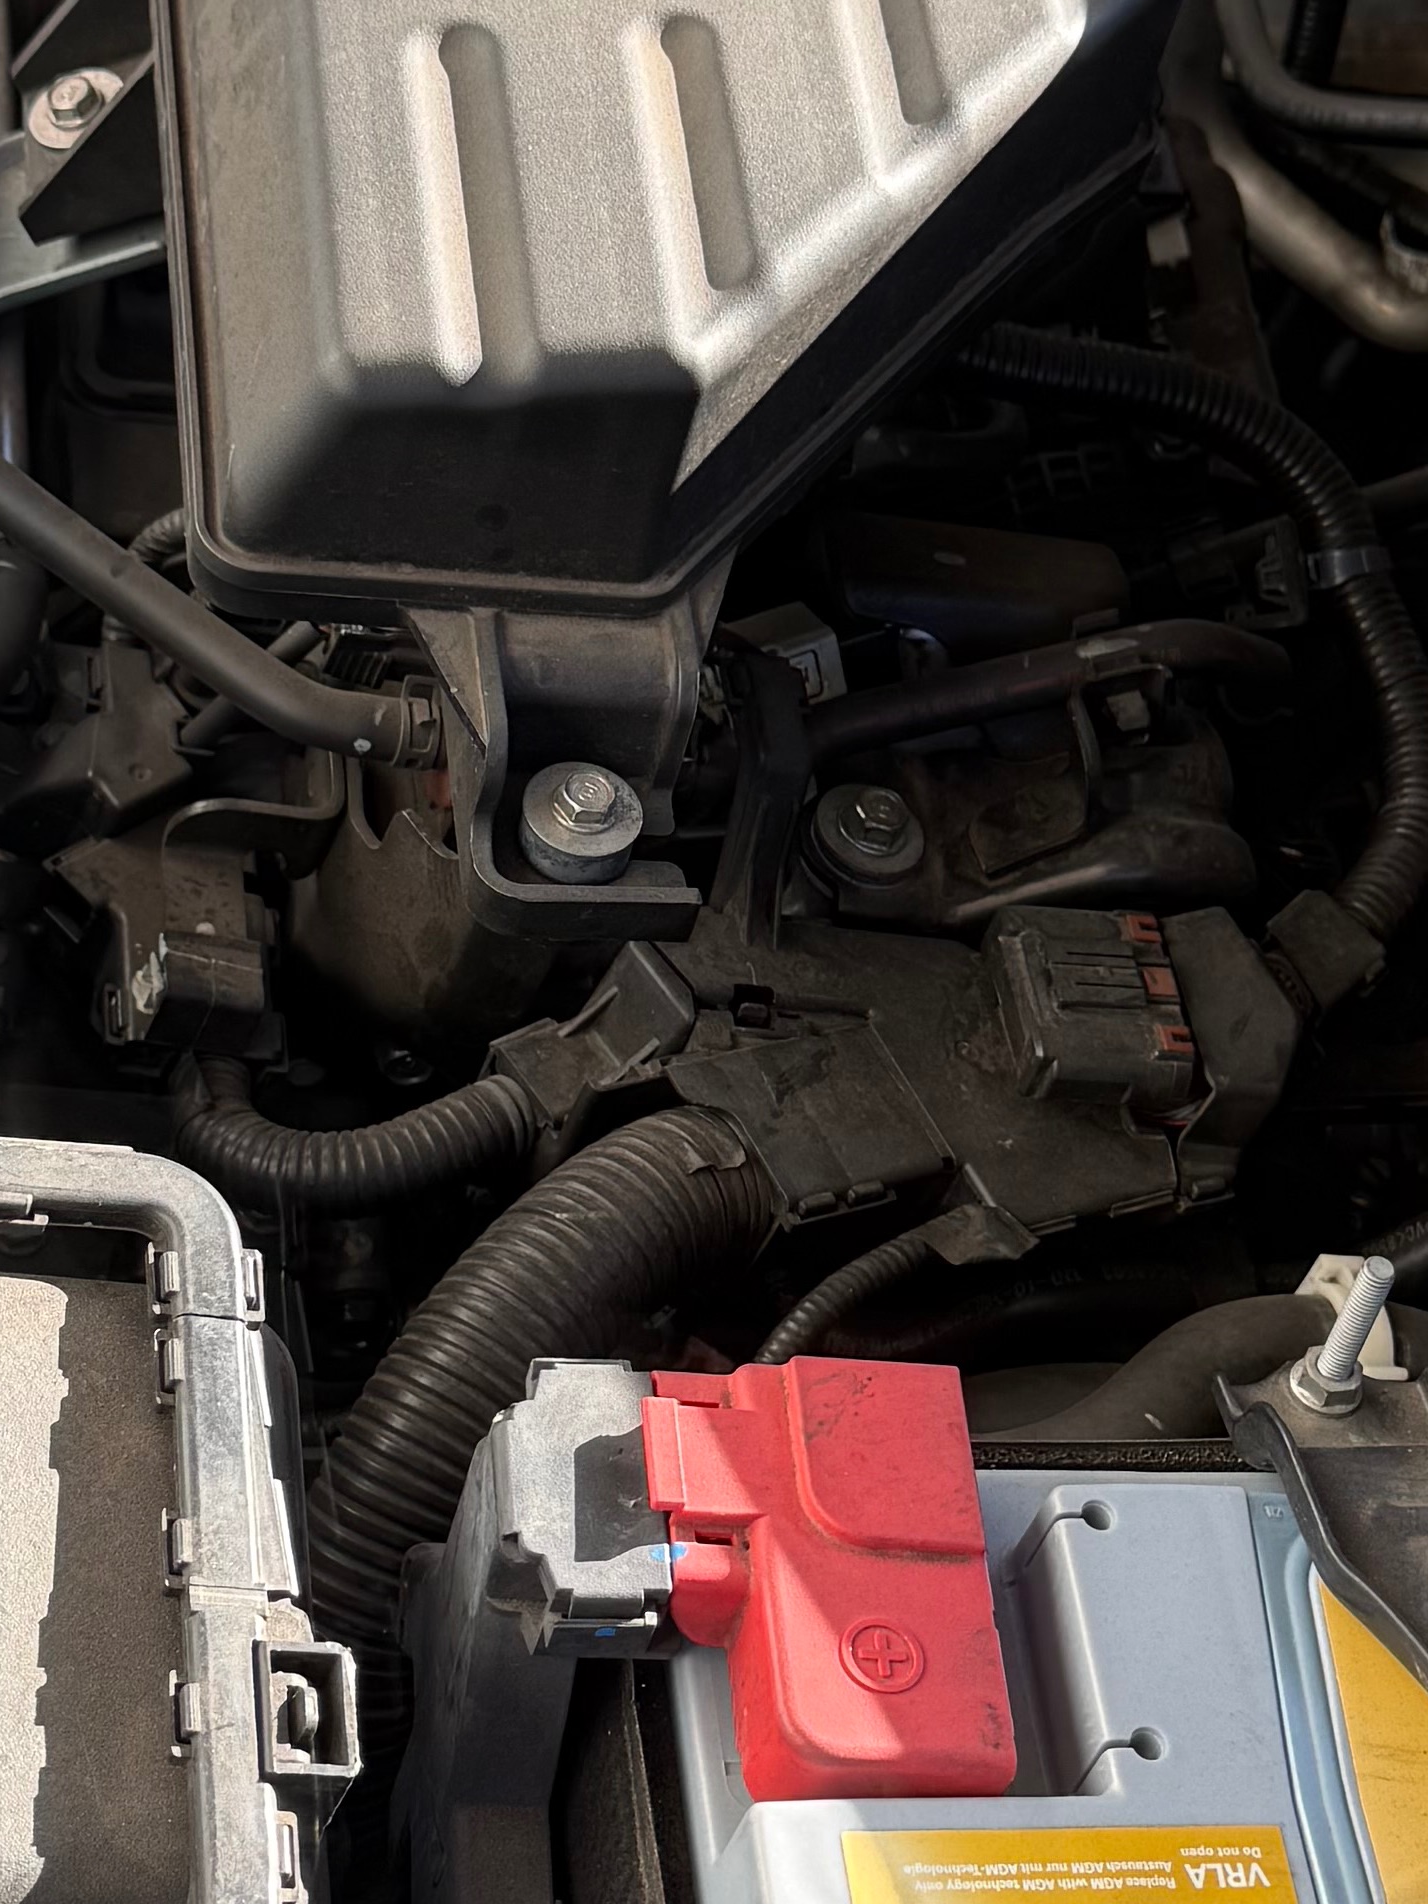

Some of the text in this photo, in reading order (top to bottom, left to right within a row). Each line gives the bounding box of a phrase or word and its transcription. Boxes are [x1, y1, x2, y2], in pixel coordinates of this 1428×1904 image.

[1180, 1844, 1262, 1859] Do not open
[1019, 1863, 1043, 1875] mit
[1046, 1863, 1068, 1873] nur
[1071, 1861, 1104, 1874] AGM
[1106, 1861, 1172, 1873] Austausch
[1126, 1875, 1176, 1889] Replace
[1183, 1862, 1270, 1890] VRLA
[947, 1878, 1020, 1892] technology
[1023, 1878, 1055, 1891] AGM
[1057, 1877, 1088, 1891] with
[1091, 1877, 1123, 1890] AGM
